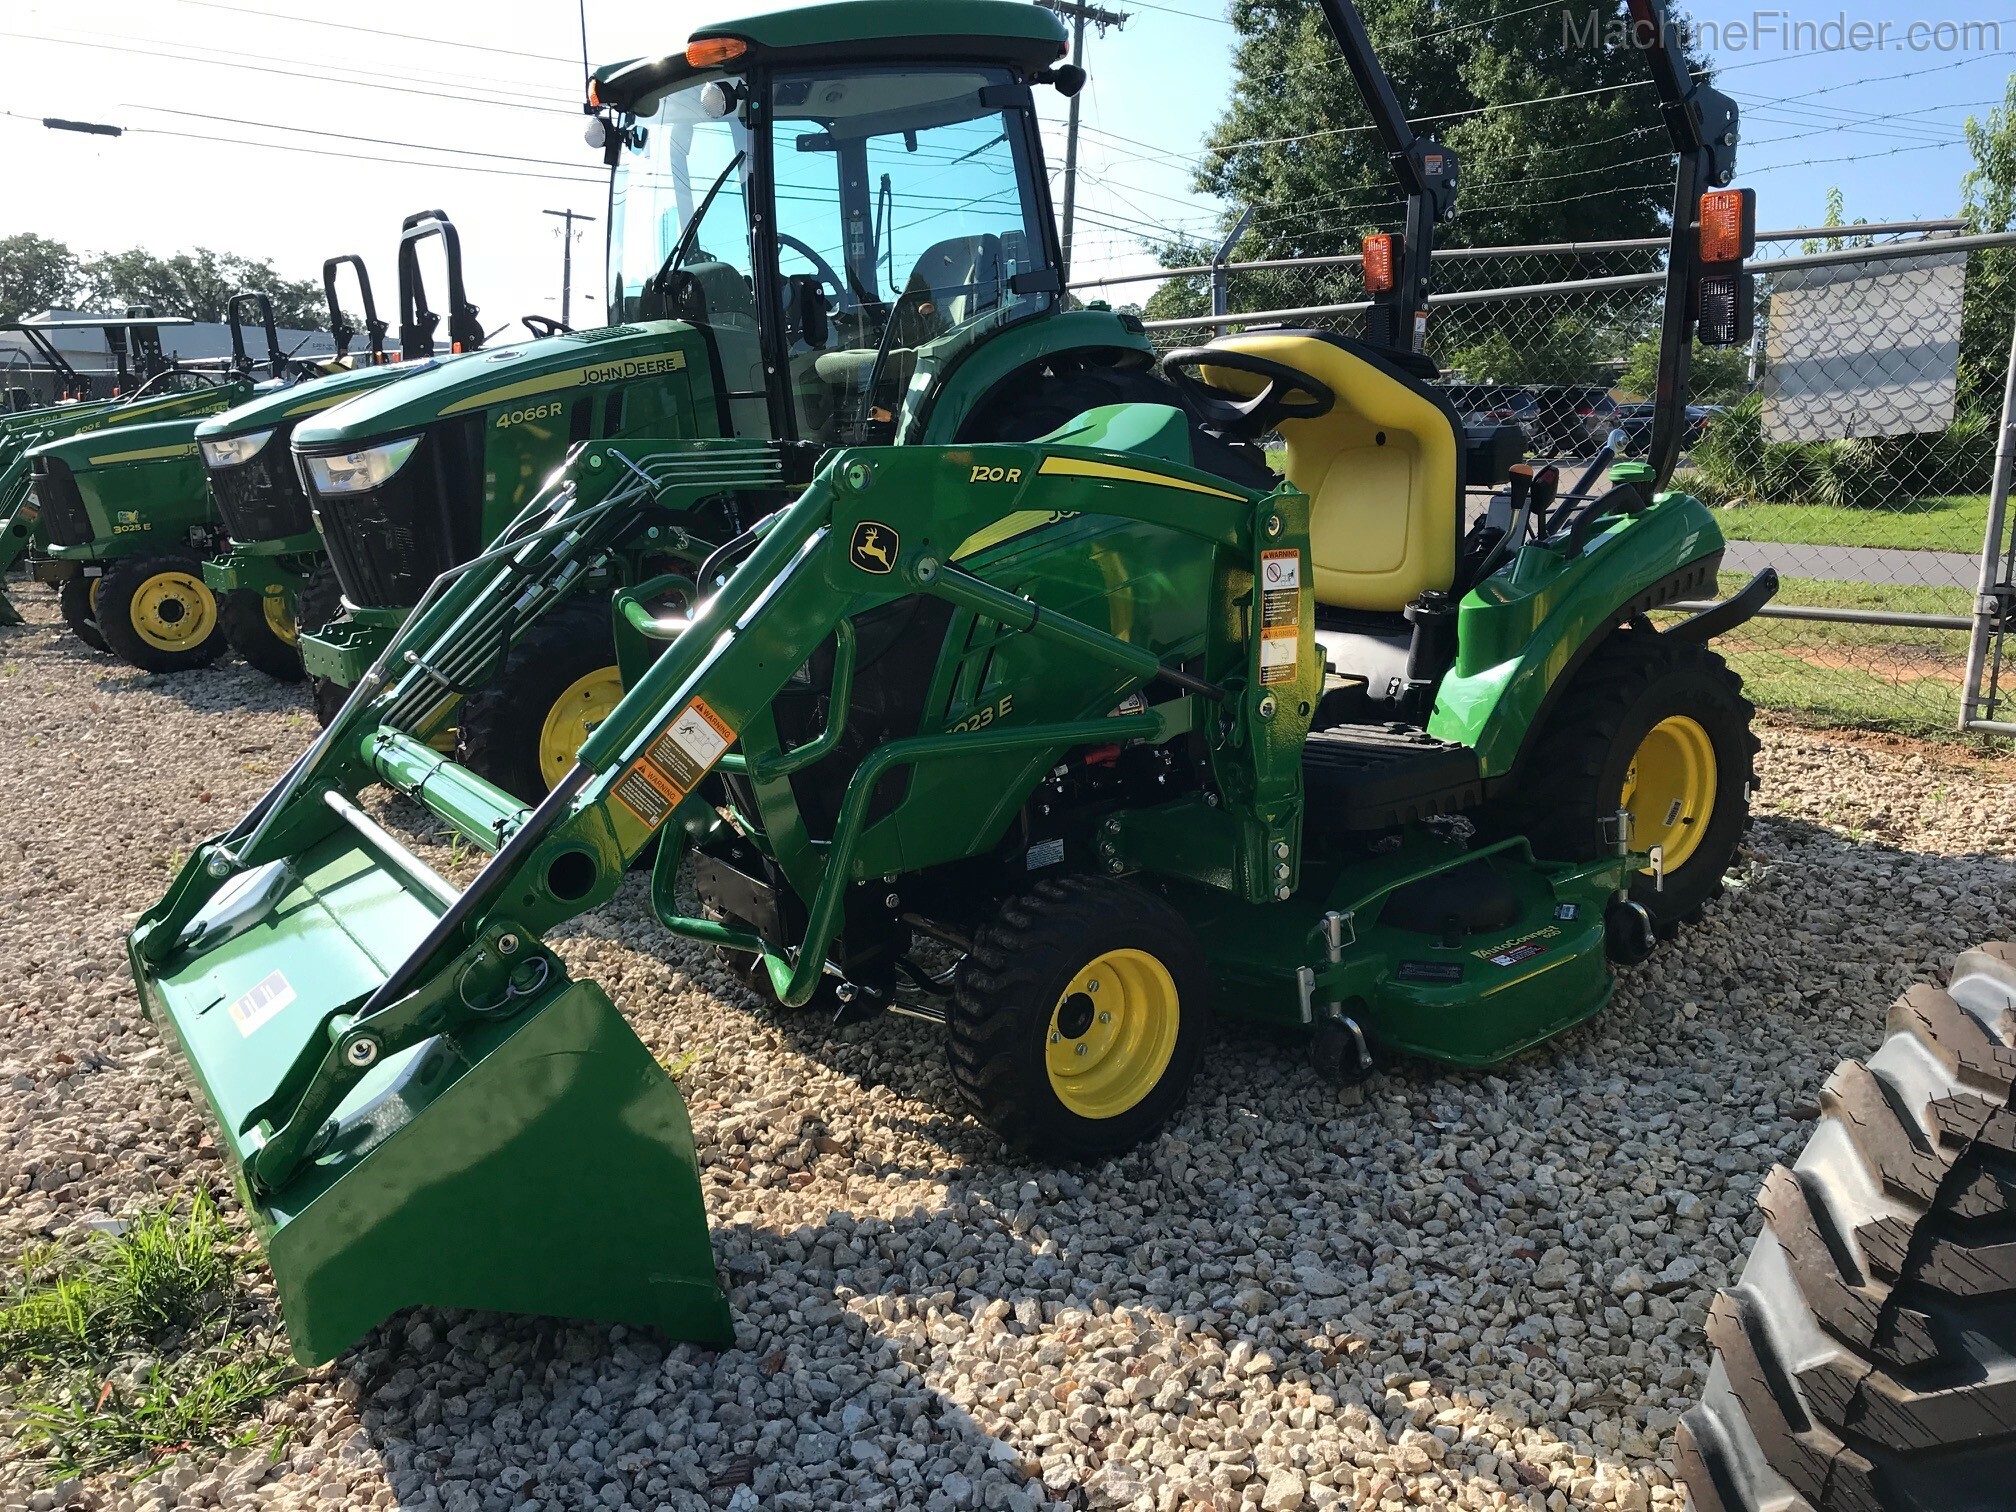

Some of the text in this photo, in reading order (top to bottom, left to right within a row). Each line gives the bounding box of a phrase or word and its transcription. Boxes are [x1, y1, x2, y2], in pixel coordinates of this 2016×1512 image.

[579, 358, 676, 385] JOHN DEERE
[75, 423, 95, 434] 400
[496, 402, 563, 429] 4066 R
[969, 466, 1022, 483] 120 R
[113, 522, 151, 534] 3025 E
[1269, 550, 1298, 559] WARNING
[703, 709, 731, 738] WARNING
[945, 694, 1013, 734] 023 E
[647, 771, 676, 800] WARNING
[1479, 925, 1560, 959] AutoConnect
